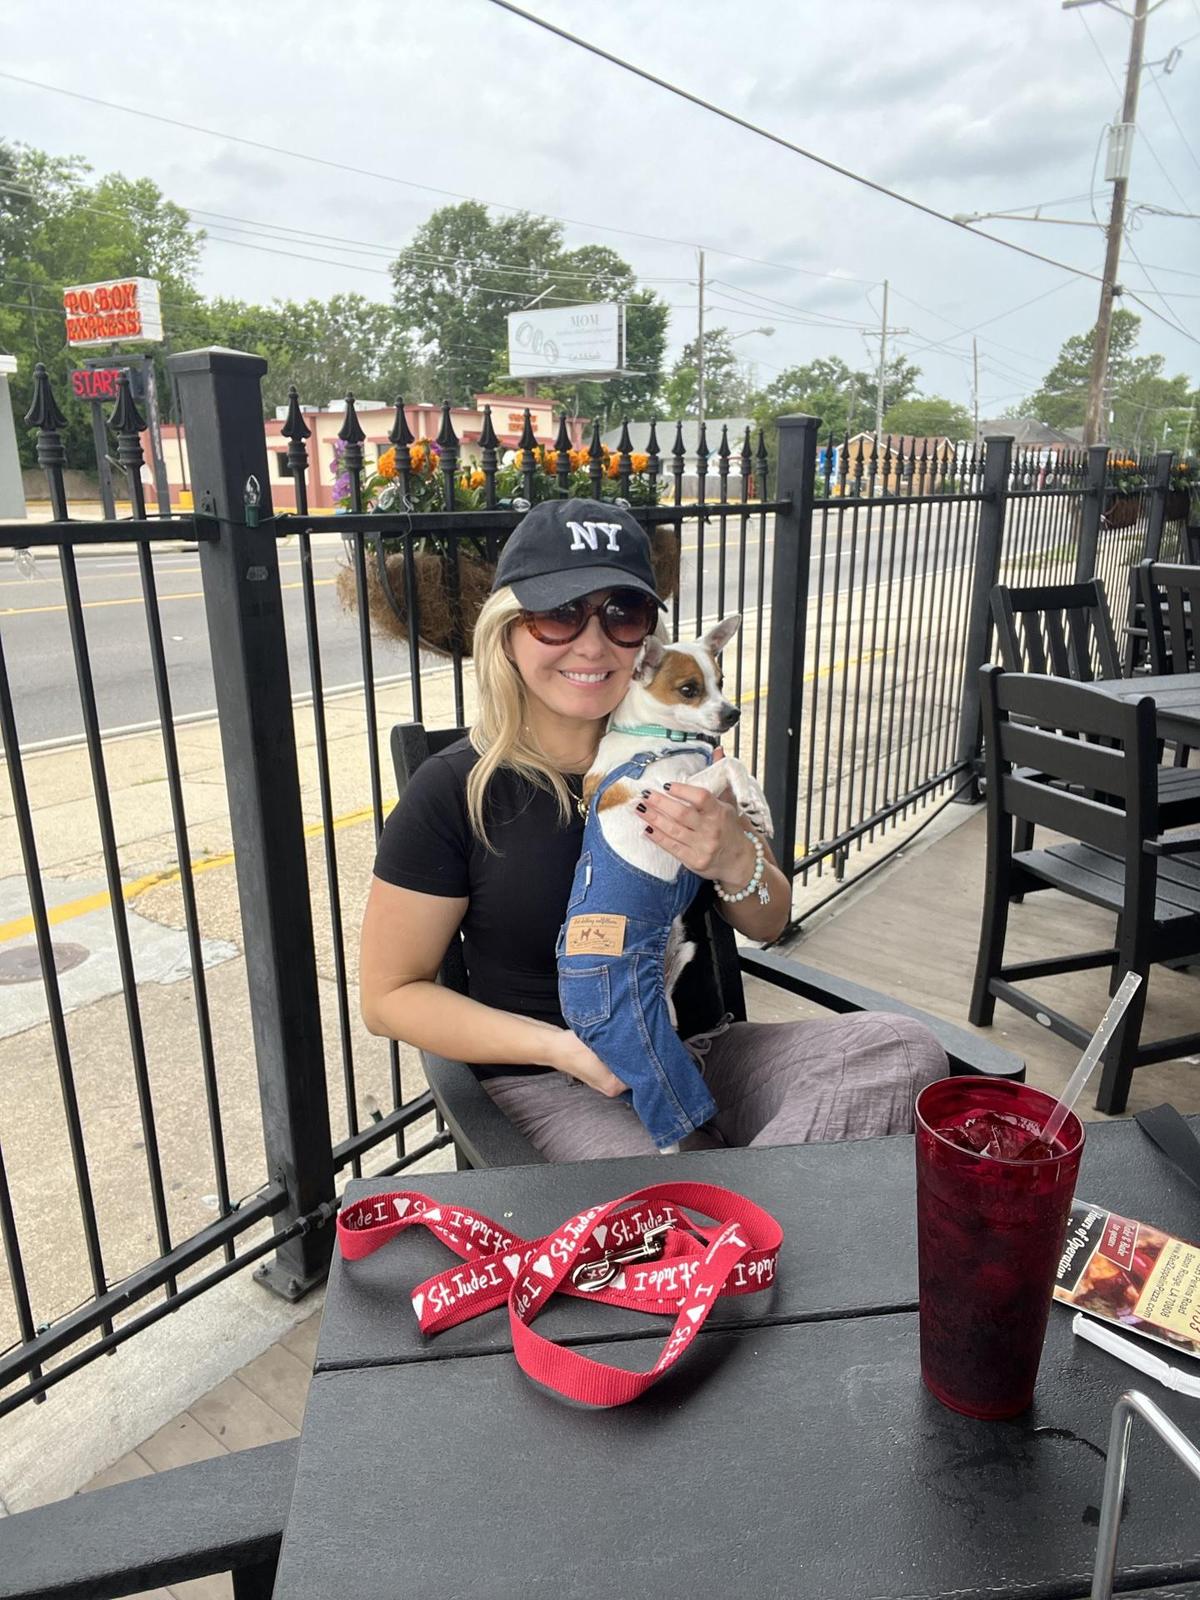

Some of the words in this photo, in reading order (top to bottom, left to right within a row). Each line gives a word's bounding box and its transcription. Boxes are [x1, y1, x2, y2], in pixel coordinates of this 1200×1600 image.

[66, 311, 142, 341] EXPRESS
[566, 521, 622, 552] NY
[1080, 1208, 1103, 1230] Hours
[1073, 1227, 1090, 1242] of
[1056, 1237, 1086, 1279] Operation
[1169, 1287, 1180, 1298] LA
[1177, 1297, 1193, 1316] Road
